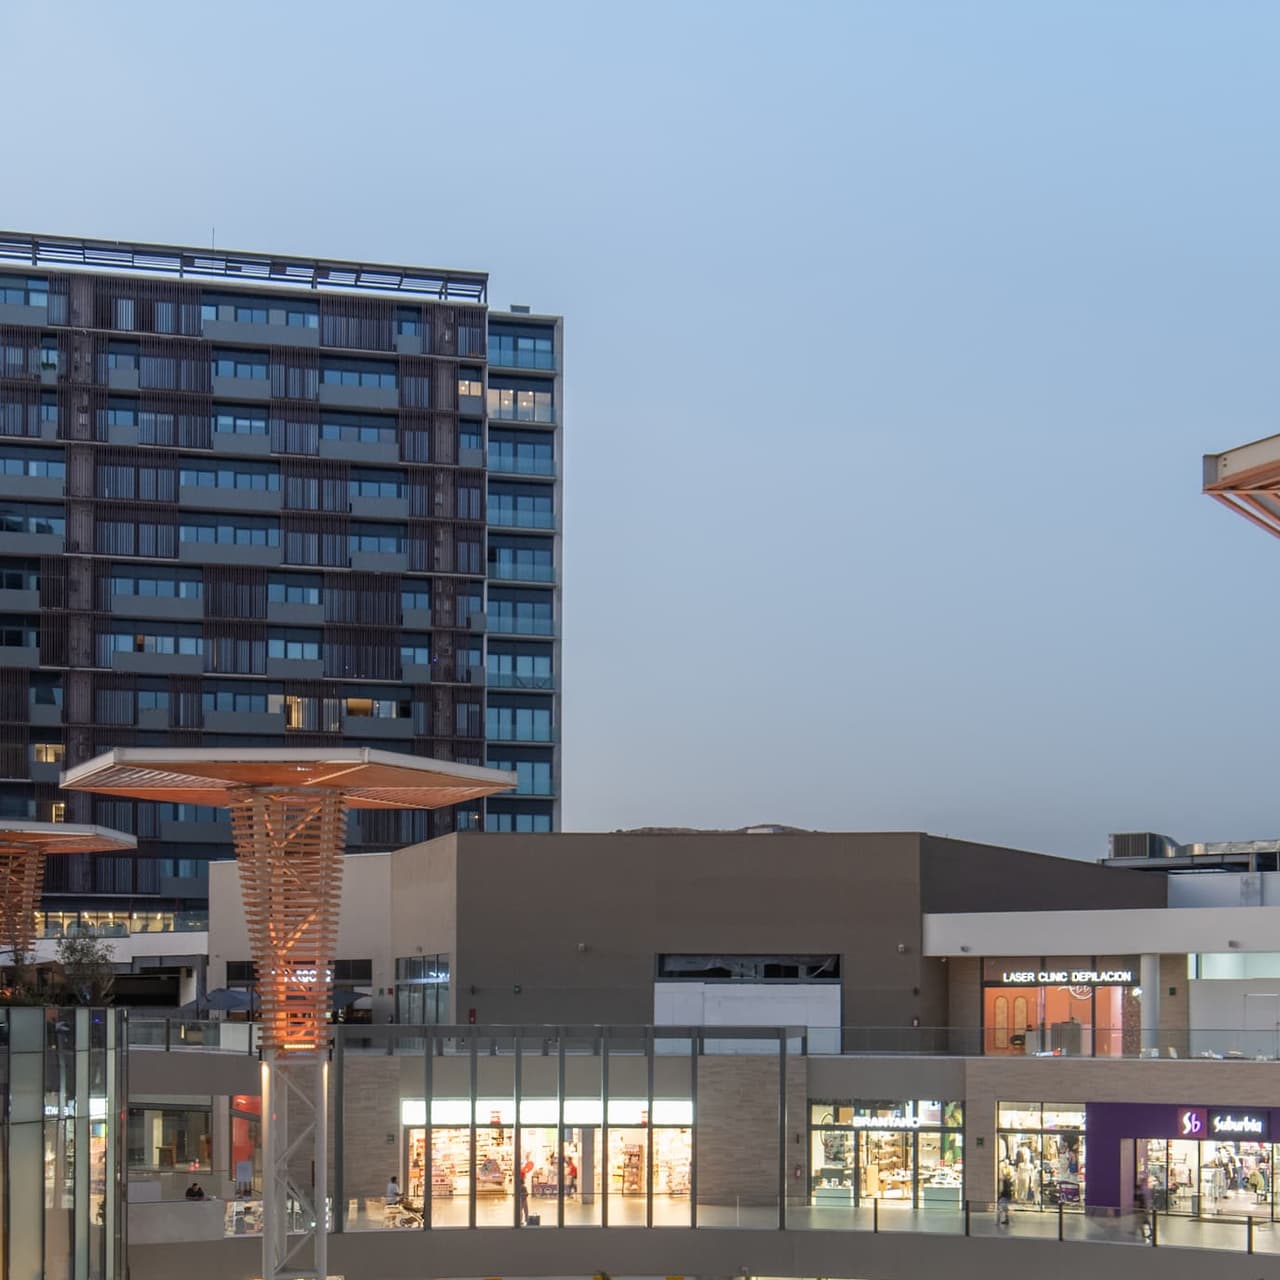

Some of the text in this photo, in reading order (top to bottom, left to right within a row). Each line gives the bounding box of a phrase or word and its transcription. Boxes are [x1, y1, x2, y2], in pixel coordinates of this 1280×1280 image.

[1002, 972, 1035, 982] LASER
[1071, 971, 1132, 982] DEPILACION
[1183, 1112, 1264, 1134] Sb Suburbia
